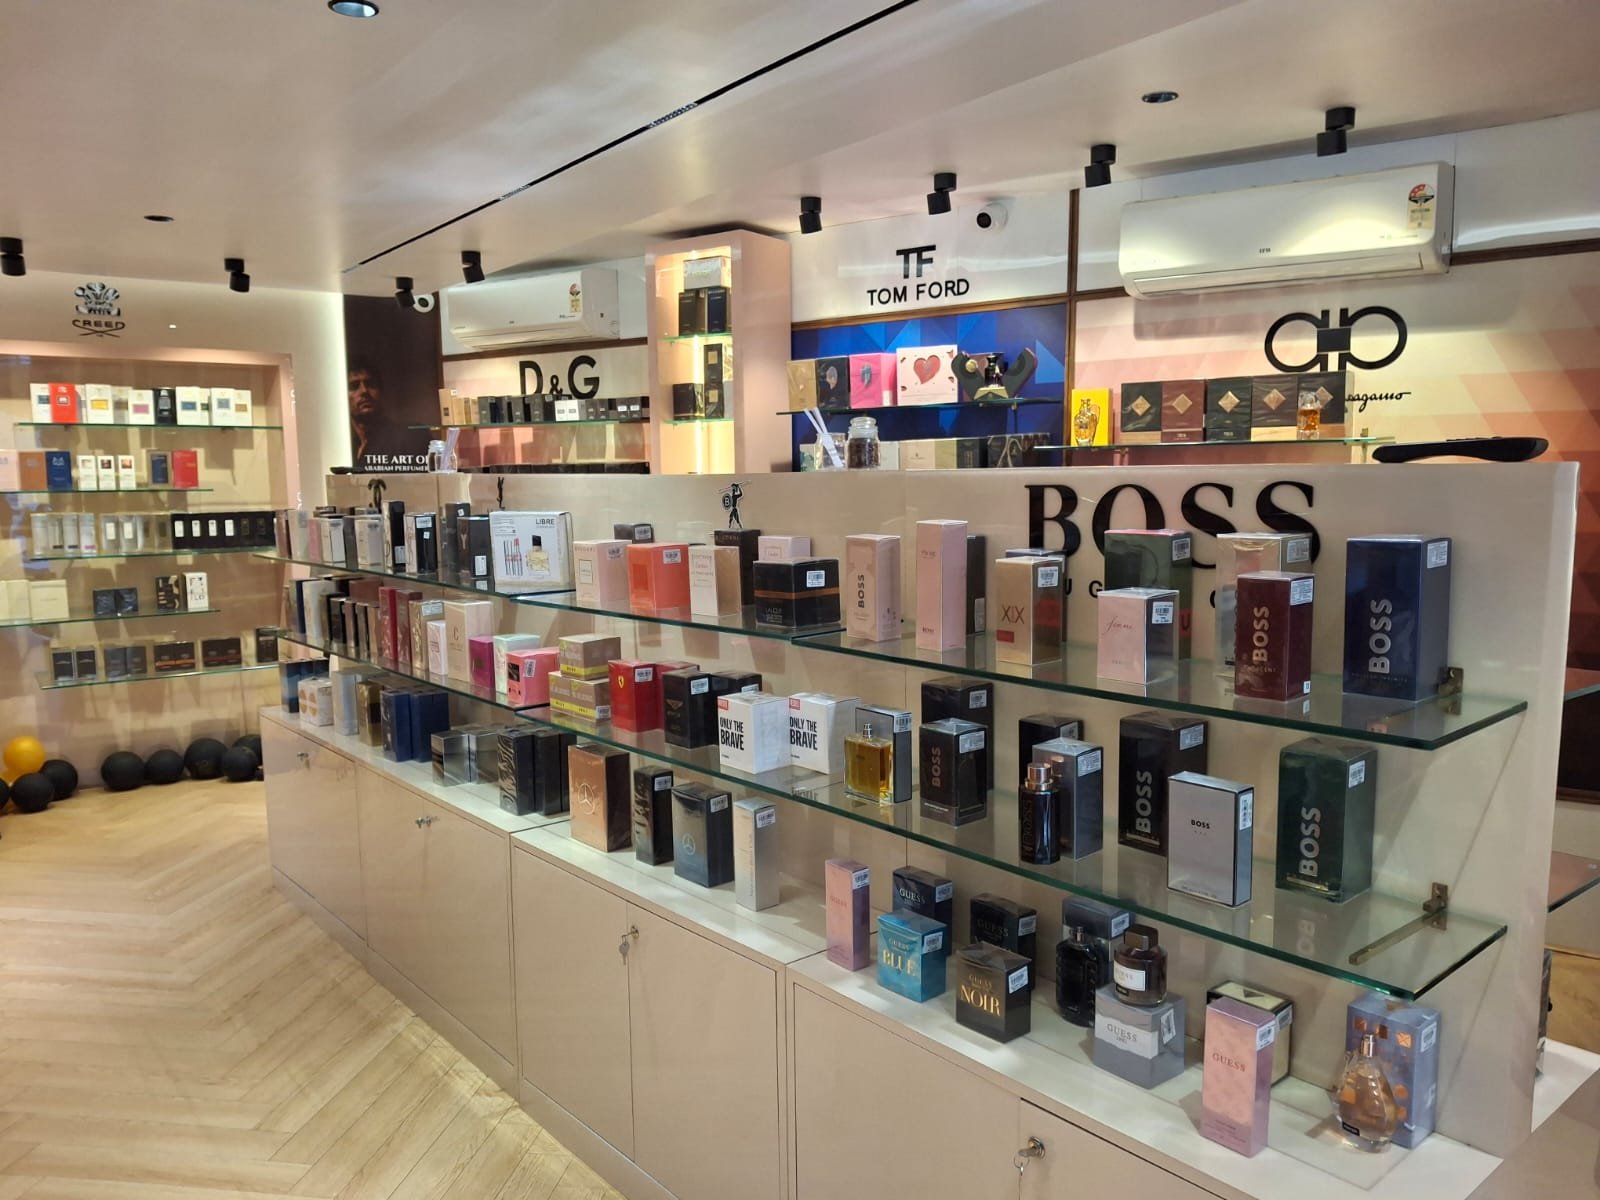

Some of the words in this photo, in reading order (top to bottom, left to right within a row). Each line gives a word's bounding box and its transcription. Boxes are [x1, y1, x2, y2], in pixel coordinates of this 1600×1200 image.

[867, 286, 907, 306] TOM
[916, 279, 970, 300] FORD
[72, 319, 126, 331] CREED
[364, 454, 389, 464] THE
[391, 454, 413, 464] ART
[1024, 480, 1321, 570] BOSS
[857, 573, 865, 609] BOSS
[1252, 606, 1270, 665] BOSS
[1368, 598, 1392, 674] BOSS
[720, 716, 732, 730] ONLY
[734, 719, 744, 733] THE
[790, 716, 805, 730] ONLY
[806, 719, 817, 733] THE
[720, 729, 744, 751] BRAVE
[790, 729, 818, 751] BRAVE
[931, 746, 941, 787] BOSS
[1135, 771, 1153, 834] BOSS
[1190, 819, 1211, 830] BOSS
[1299, 806, 1321, 877] BOSS
[899, 887, 926, 905] GUESS
[882, 949, 917, 977] BLUE
[961, 984, 1001, 1017] NOIR
[1106, 1023, 1138, 1042] GUESS
[1211, 1052, 1246, 1073] GUESS
